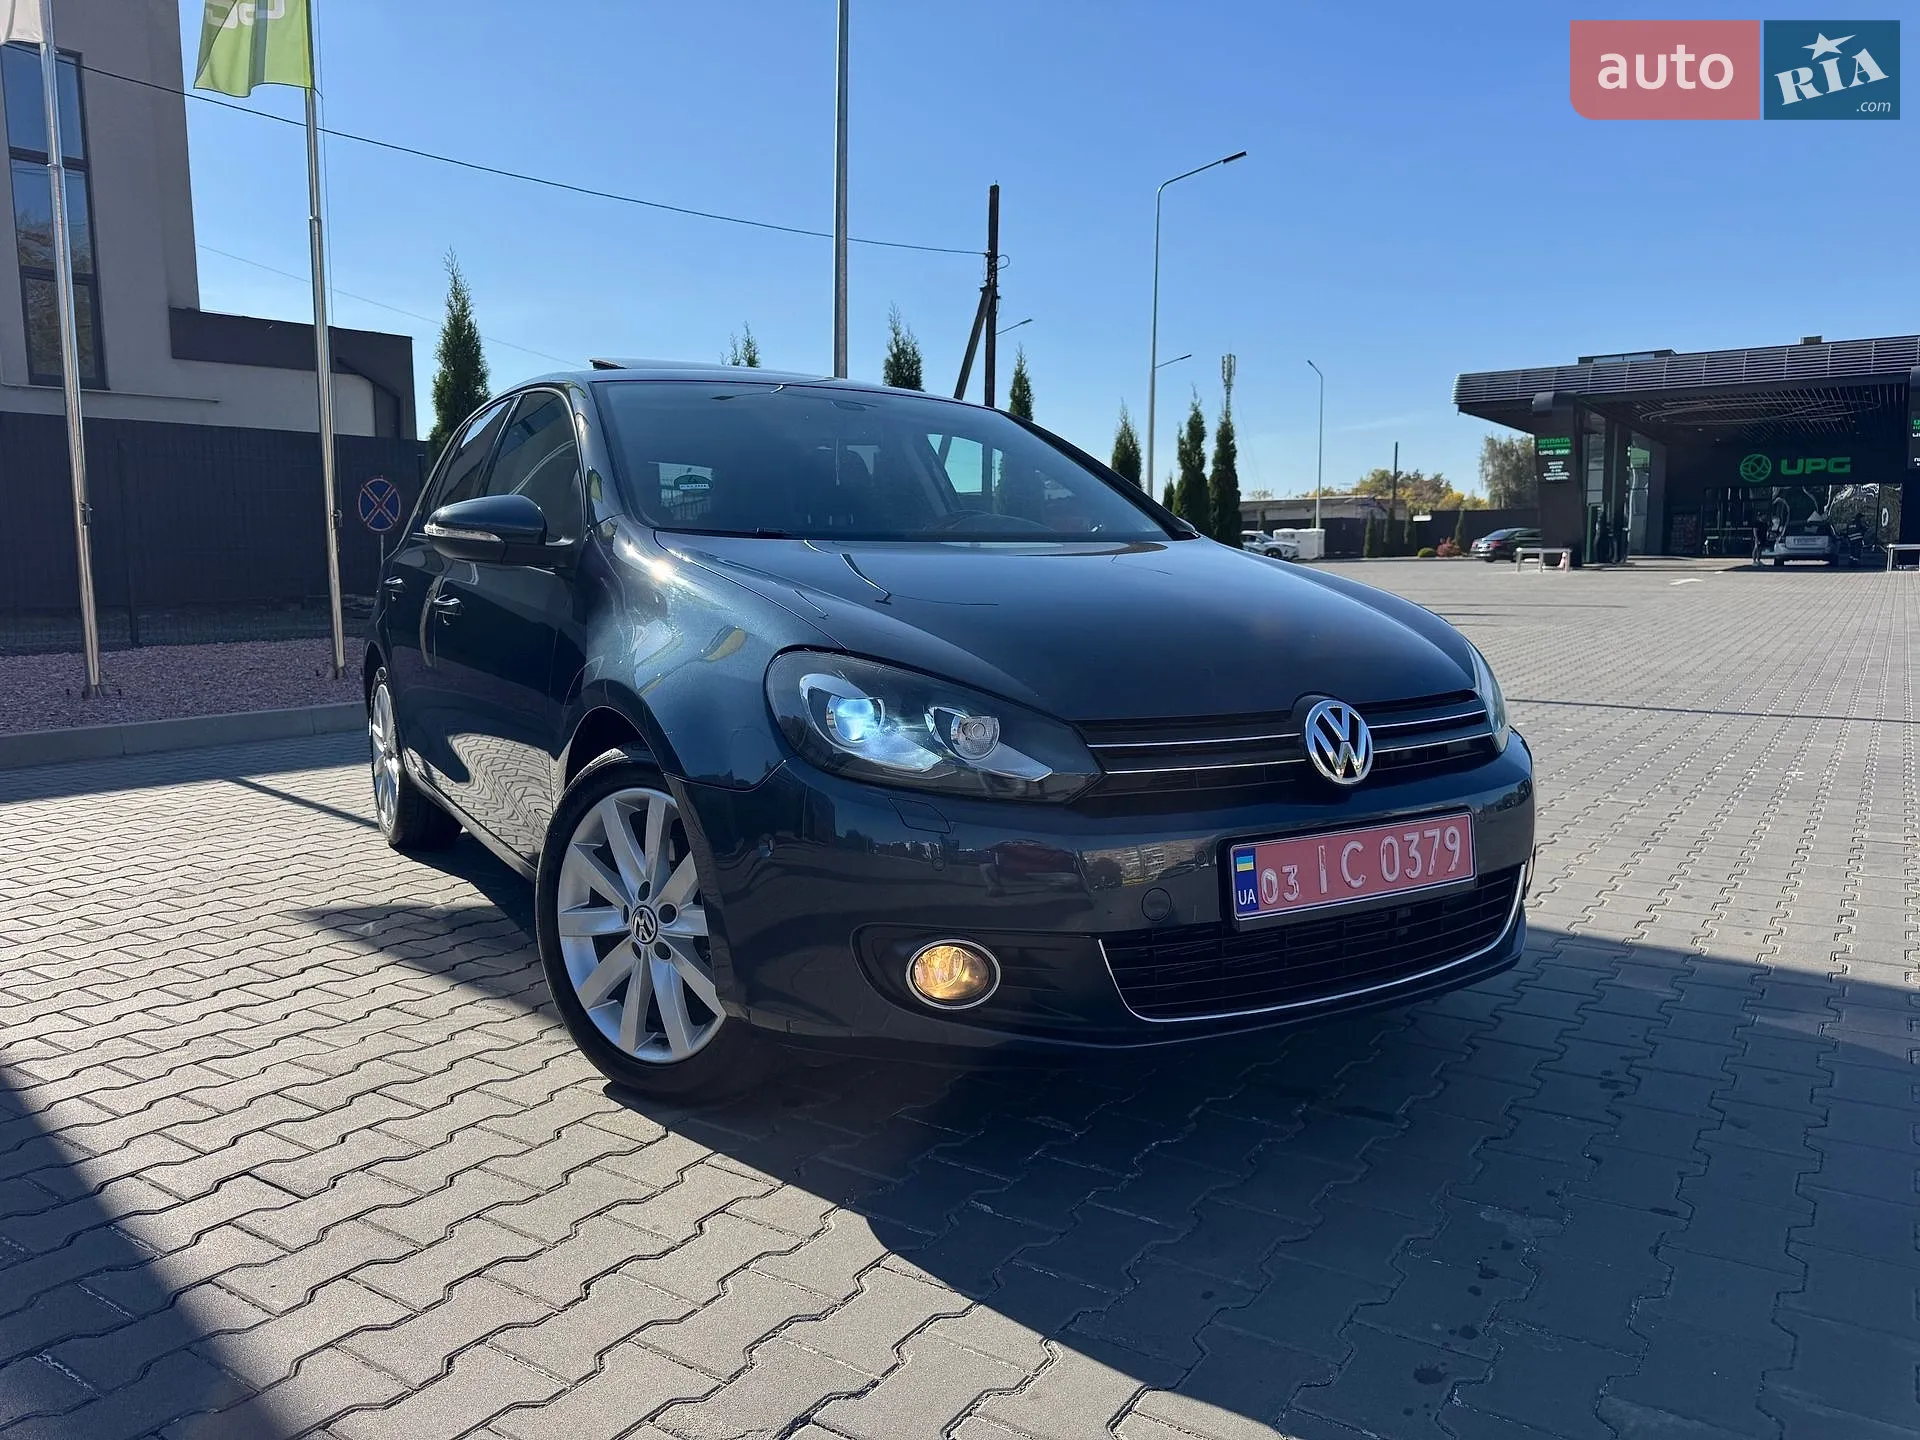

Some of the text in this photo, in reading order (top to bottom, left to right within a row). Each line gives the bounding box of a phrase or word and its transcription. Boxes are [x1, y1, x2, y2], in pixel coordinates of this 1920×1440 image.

[1780, 456, 1851, 475] UPG
[1260, 825, 1461, 905] 03 IC 0379
[1238, 888, 1257, 906] UA
